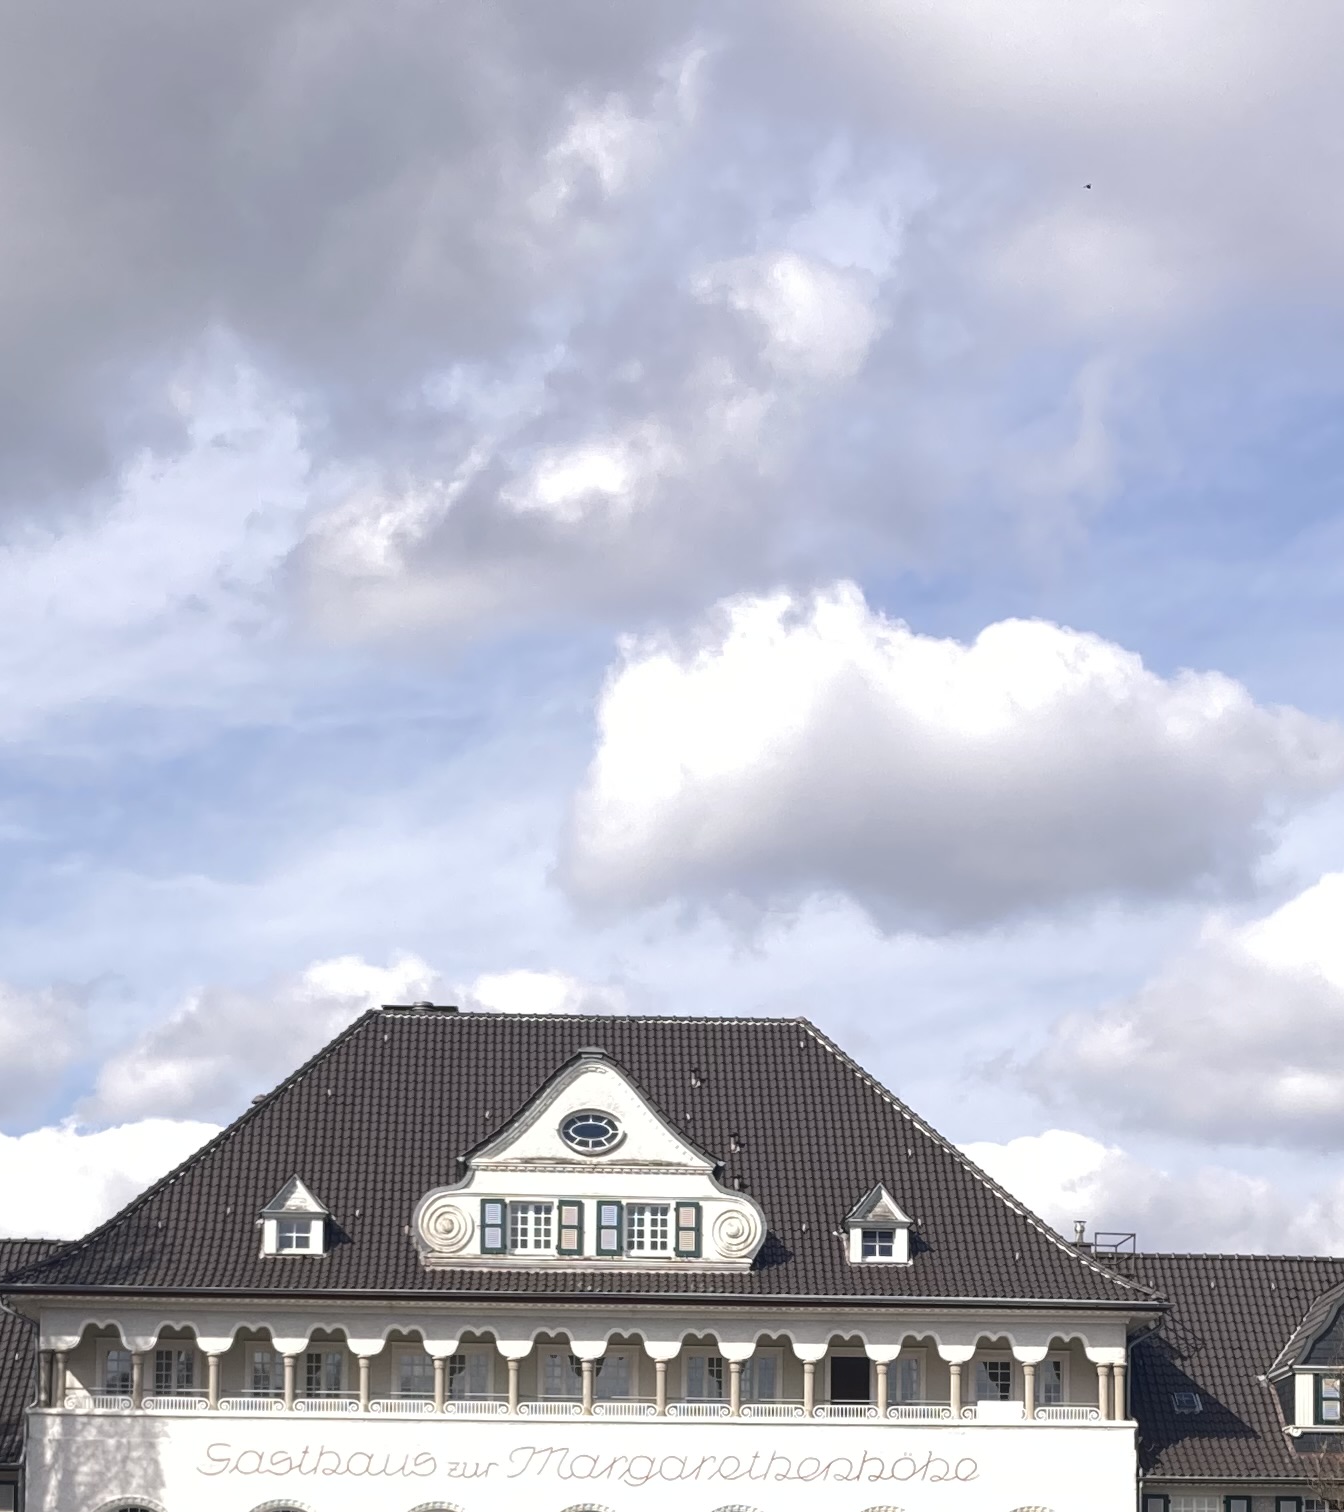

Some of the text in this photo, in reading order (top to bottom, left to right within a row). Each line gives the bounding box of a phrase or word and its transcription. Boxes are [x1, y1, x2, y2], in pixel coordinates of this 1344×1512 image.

[196, 1442, 981, 1487] Gasthaus zur Margarethenhöhe
